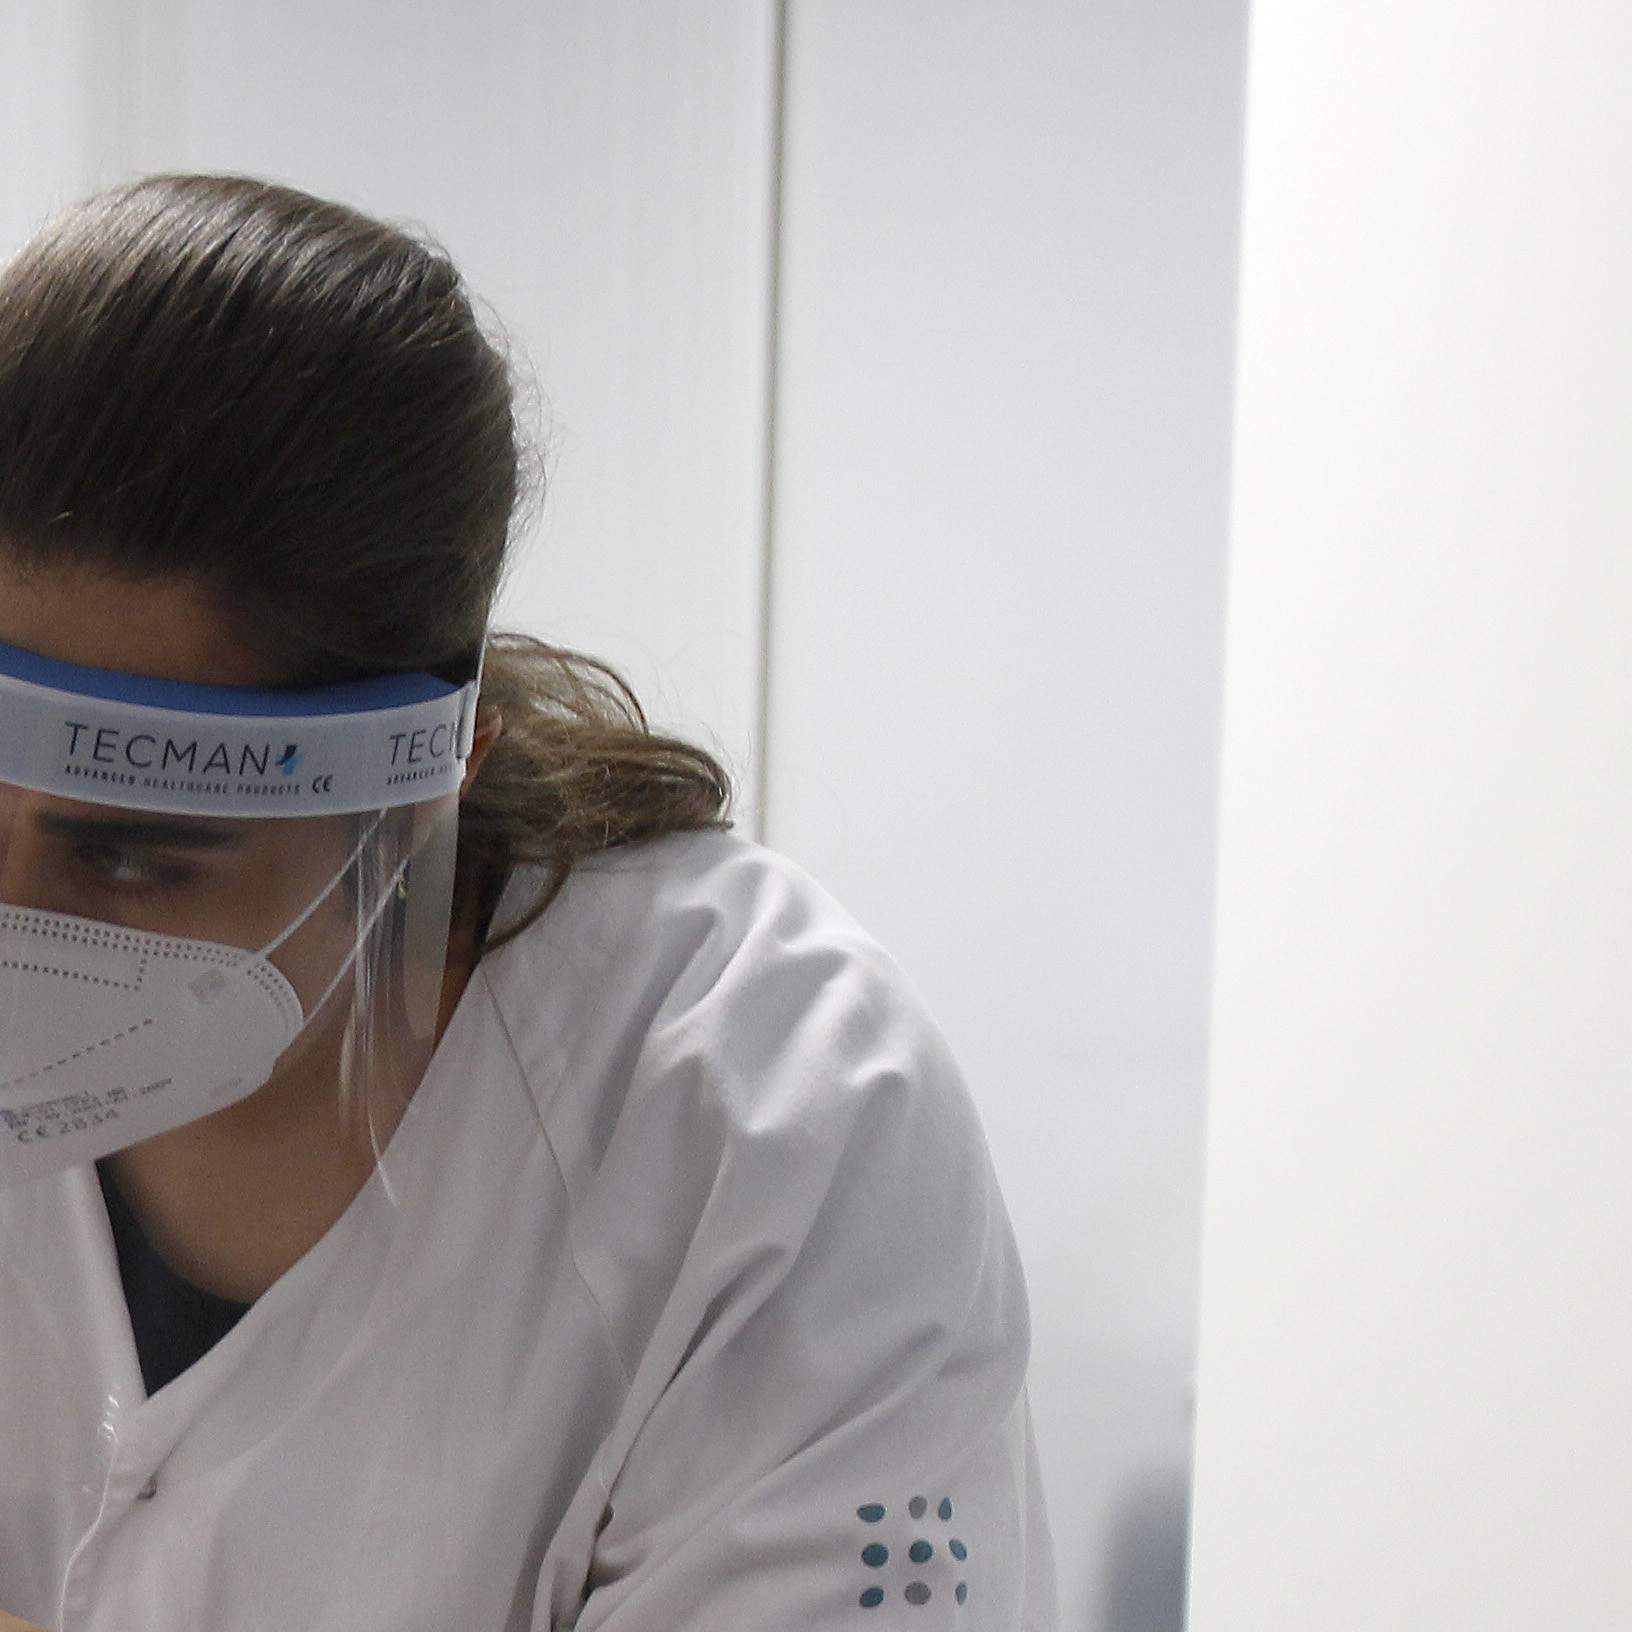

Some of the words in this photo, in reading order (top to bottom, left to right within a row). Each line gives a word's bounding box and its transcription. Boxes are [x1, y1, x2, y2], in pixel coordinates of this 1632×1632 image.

[64, 720, 271, 777] TECMAN
[64, 764, 135, 786] ADVANCED
[143, 777, 229, 795] HEALTHCARE
[237, 784, 301, 796] PRODUCTS
